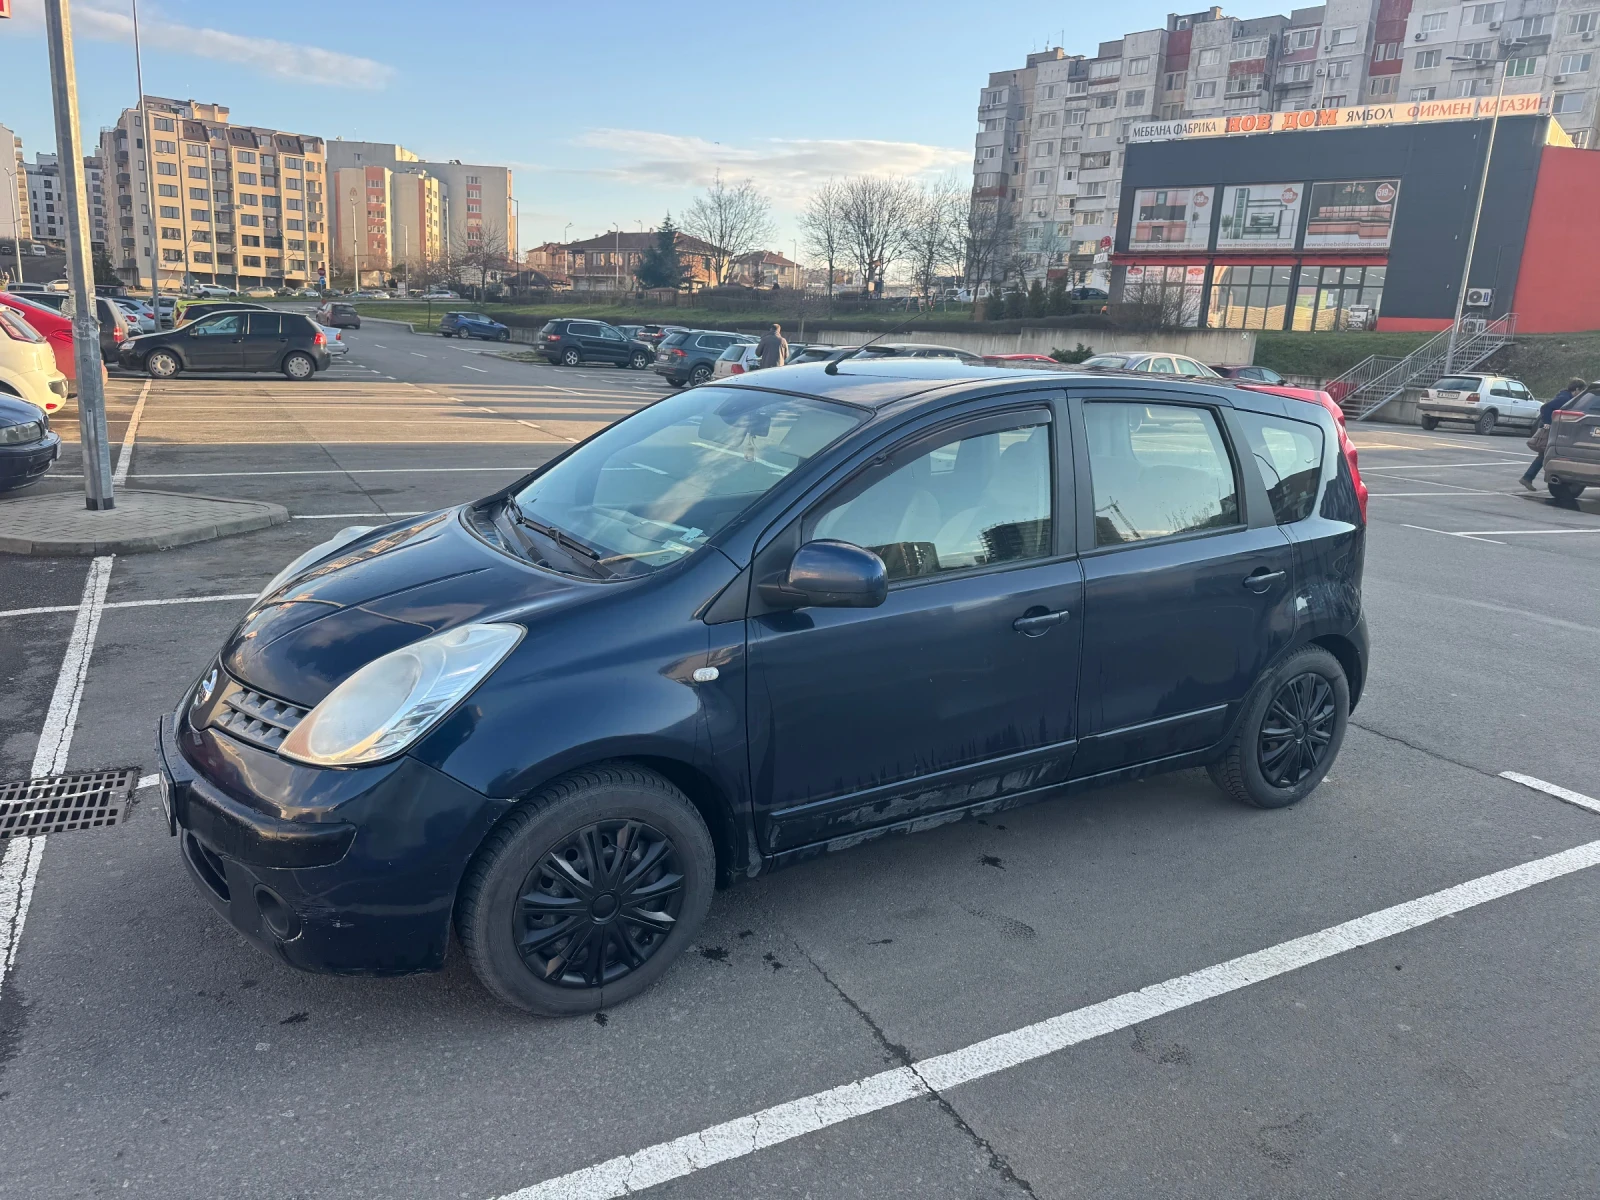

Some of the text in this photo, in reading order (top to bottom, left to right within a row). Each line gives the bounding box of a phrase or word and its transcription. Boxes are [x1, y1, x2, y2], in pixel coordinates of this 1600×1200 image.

[1132, 96, 1551, 138] МЕБЕЛНА ФАБРИКА НОВ ДОМ ЯМБОЛ ФИРМЕН МАГАЗИН
[1305, 240, 1387, 248] www.mebelinovdom.com
